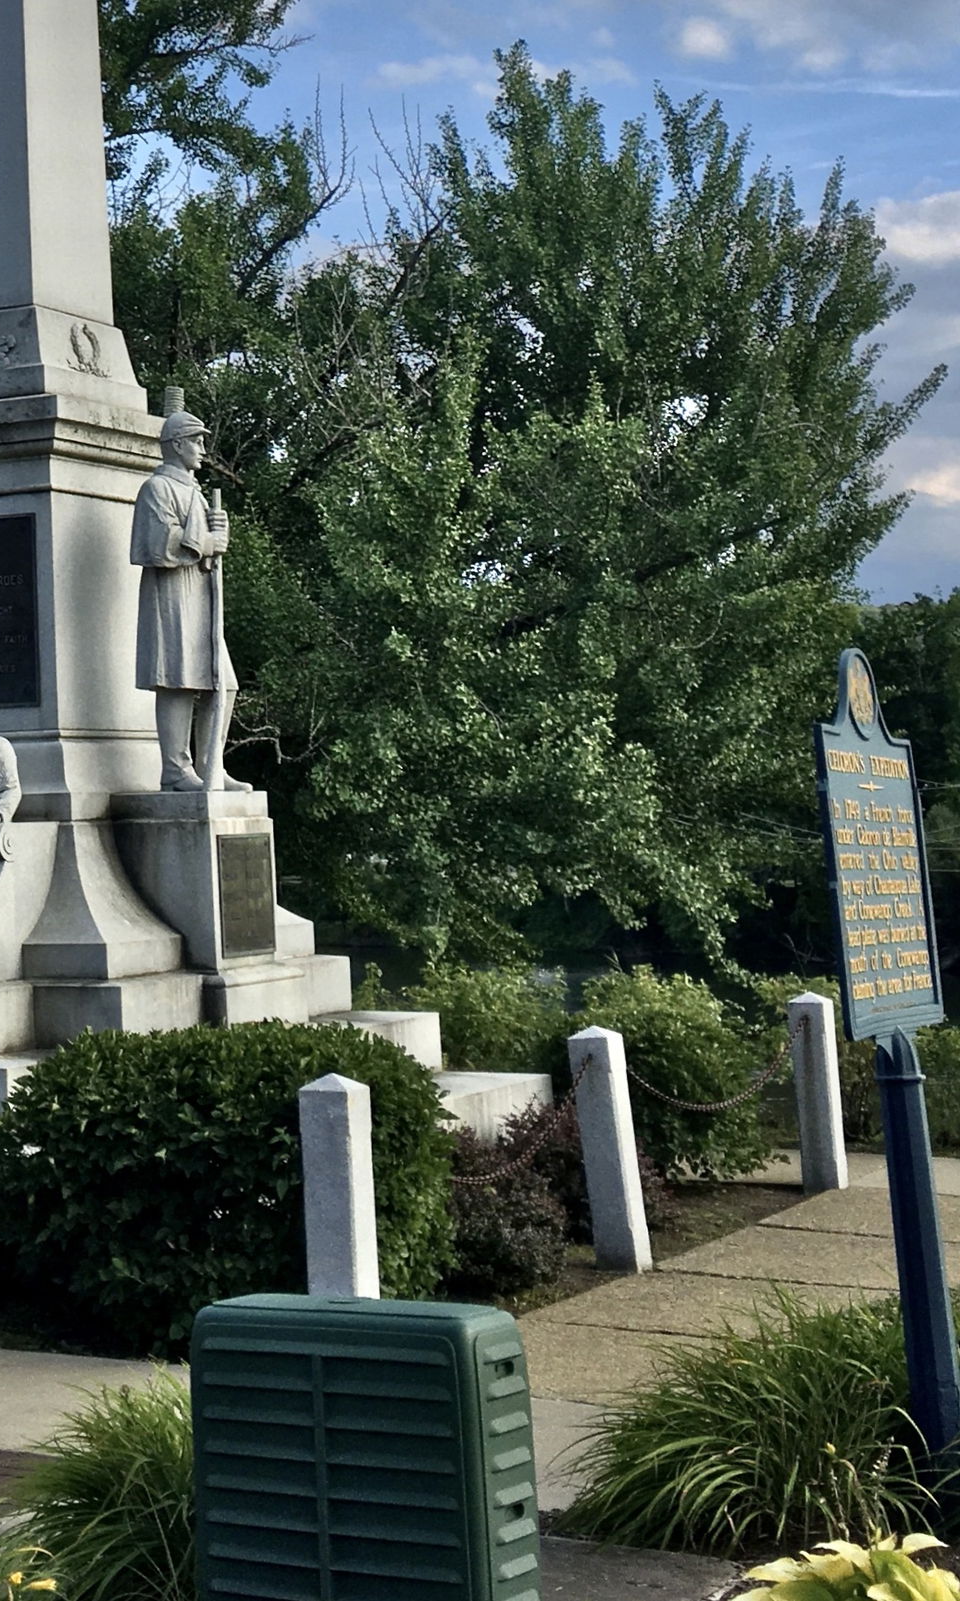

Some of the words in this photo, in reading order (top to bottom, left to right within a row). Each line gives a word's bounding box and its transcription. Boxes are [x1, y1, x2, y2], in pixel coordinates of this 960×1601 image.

[869, 756, 910, 780] EXPEDITION
[832, 798, 841, 819] In
[844, 799, 860, 820] 1749
[864, 807, 870, 821] a
[870, 801, 894, 823] French
[836, 825, 854, 845] under
[882, 827, 891, 847] de
[839, 851, 865, 870] entered
[868, 852, 881, 870] the
[882, 850, 898, 870] Ohio
[841, 876, 851, 900] by
[851, 881, 865, 900] way
[865, 876, 873, 896] of
[907, 875, 922, 895] Lake
[844, 900, 858, 921] and
[847, 926, 861, 947] lead
[878, 931, 890, 944] was
[910, 927, 918, 941] at
[917, 922, 928, 941] the
[850, 952, 867, 974] mouth
[871, 950, 879, 971] of
[881, 951, 893, 969] the
[876, 977, 888, 997] the
[903, 972, 913, 991] for
